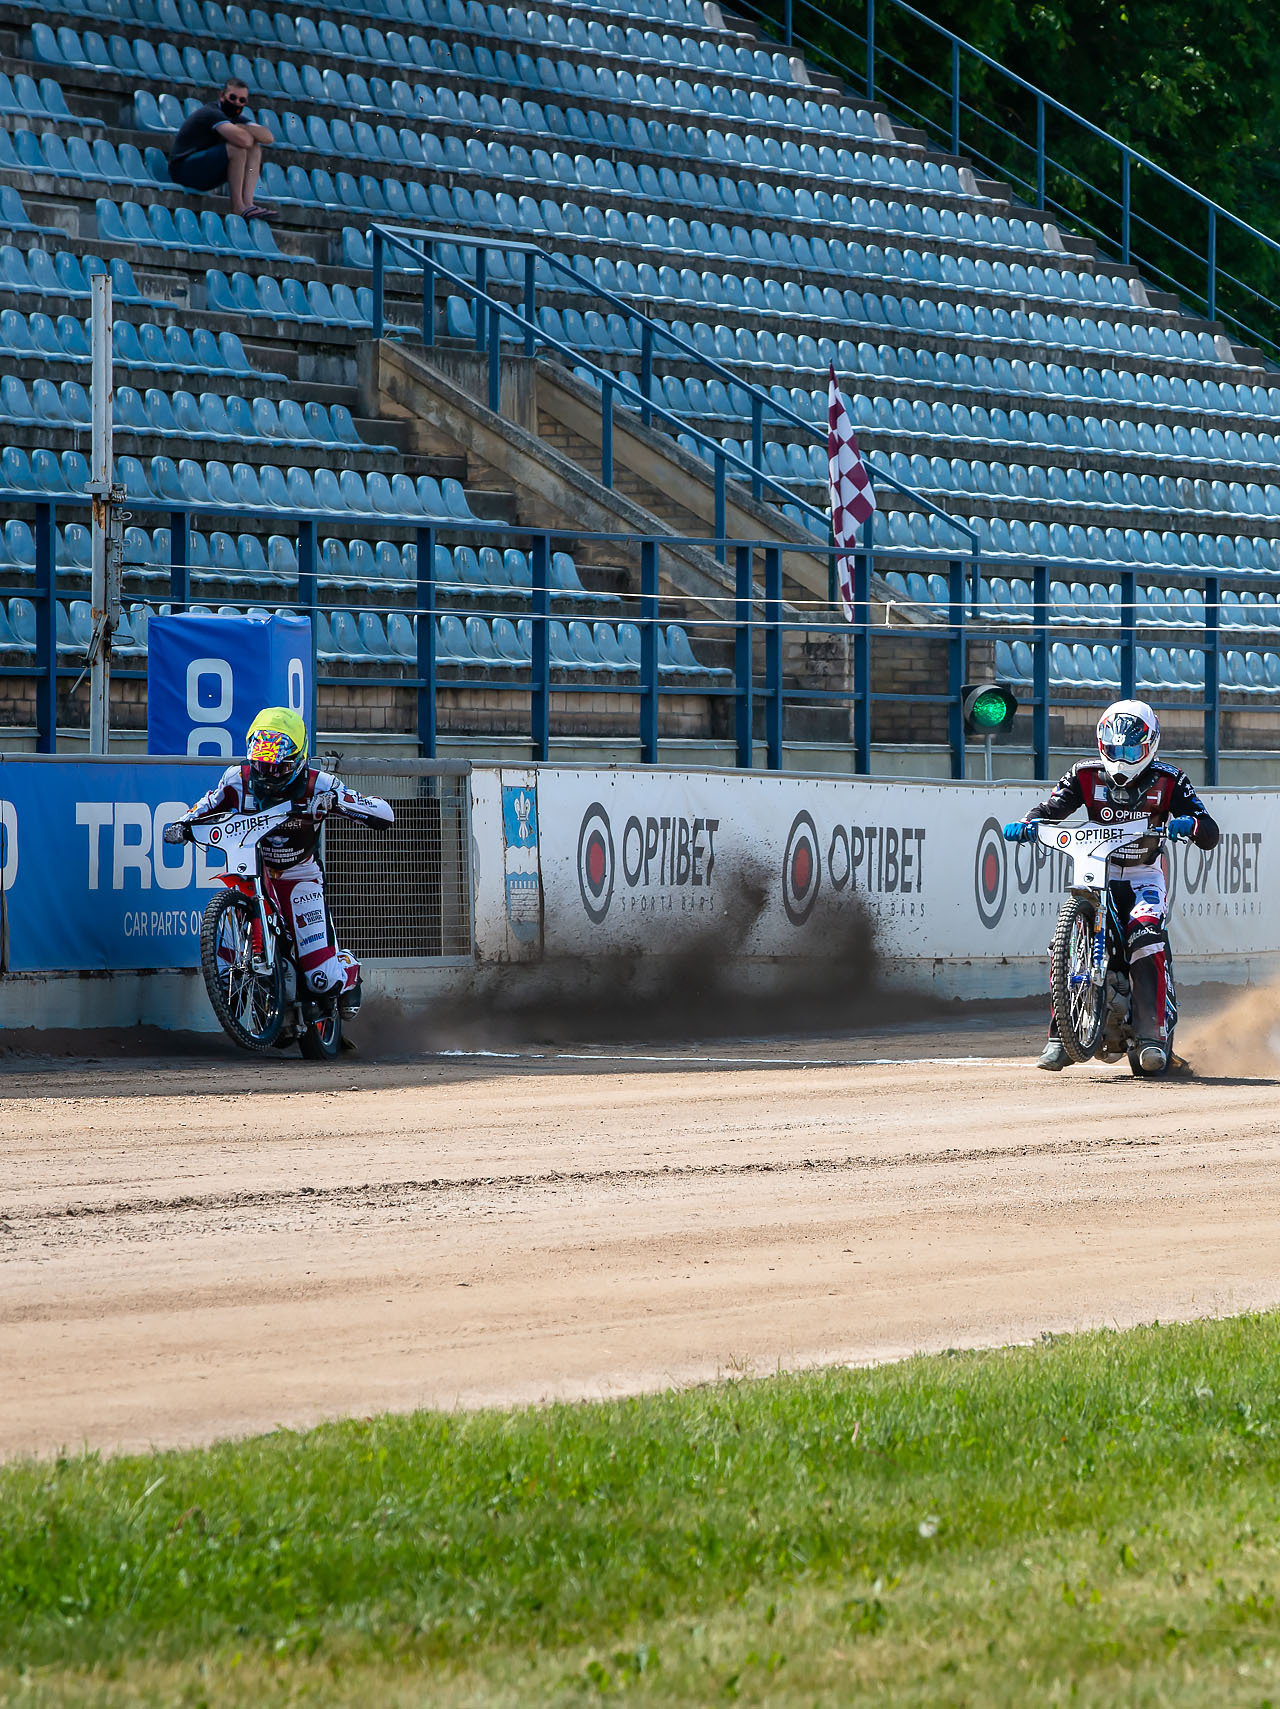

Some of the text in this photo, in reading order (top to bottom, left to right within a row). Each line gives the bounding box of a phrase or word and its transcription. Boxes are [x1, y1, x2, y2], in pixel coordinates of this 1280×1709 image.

[224, 814, 270, 836] OPTIBET
[1075, 828, 1124, 841] OPTIBET
[622, 815, 720, 888] OPTIBET
[828, 824, 926, 893] OPTIBET
[1183, 832, 1263, 895] OPTIBET
[124, 912, 148, 937] CAR
[151, 911, 187, 937] PARTS
